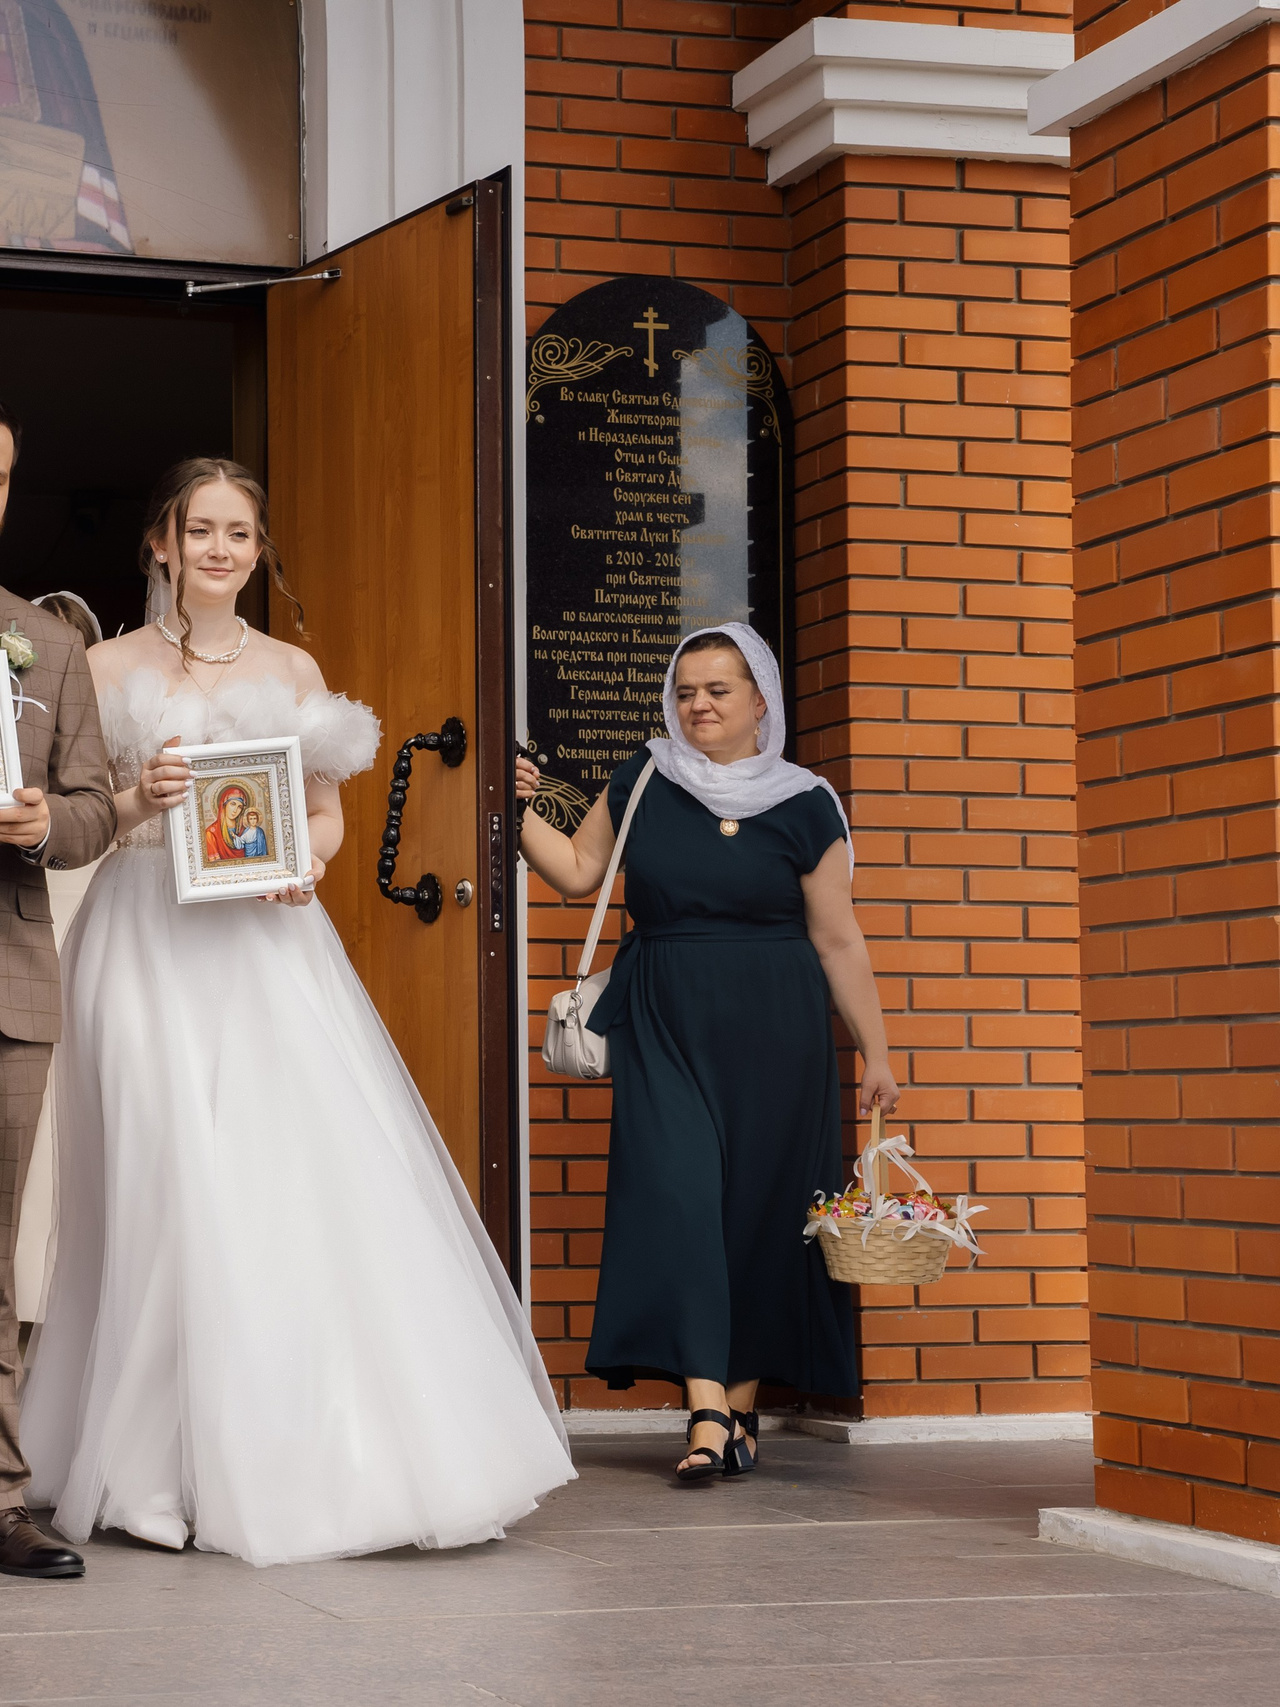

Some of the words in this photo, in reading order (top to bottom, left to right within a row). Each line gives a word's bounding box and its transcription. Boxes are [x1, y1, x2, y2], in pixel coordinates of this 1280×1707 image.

[560, 386, 574, 401] Во
[577, 391, 609, 407] славу
[612, 389, 659, 406] Святыя
[578, 431, 585, 441] и
[589, 427, 674, 446] Нераздельныя
[614, 448, 645, 466] Отца
[648, 454, 655, 464] и
[658, 450, 688, 466] Сына
[605, 471, 612, 481] и
[615, 467, 664, 484] Святаго
[613, 487, 669, 507] Сооружен
[615, 511, 643, 525] храм
[646, 512, 653, 522] в
[656, 512, 689, 524] честь
[571, 524, 637, 542] Святителя
[640, 528, 668, 547] Луки
[606, 554, 613, 565] в
[616, 551, 644, 567] 2010
[654, 552, 682, 567] 2016
[606, 573, 626, 588] при
[595, 589, 657, 609] Патриархе
[661, 591, 708, 610] Кирилле
[563, 611, 575, 622] по
[579, 611, 663, 625] благословению
[532, 625, 619, 645] Волгоградского
[622, 633, 629, 643] и
[534, 649, 548, 659] на
[551, 650, 604, 664] средства
[607, 651, 627, 666] при
[557, 665, 624, 685] Александра
[570, 685, 620, 704] Германа
[548, 708, 569, 723] при
[572, 709, 640, 721] настоятеле
[643, 712, 650, 721] и
[557, 744, 610, 762] Освящен
[612, 750, 637, 760] епи
[581, 769, 588, 780] и
